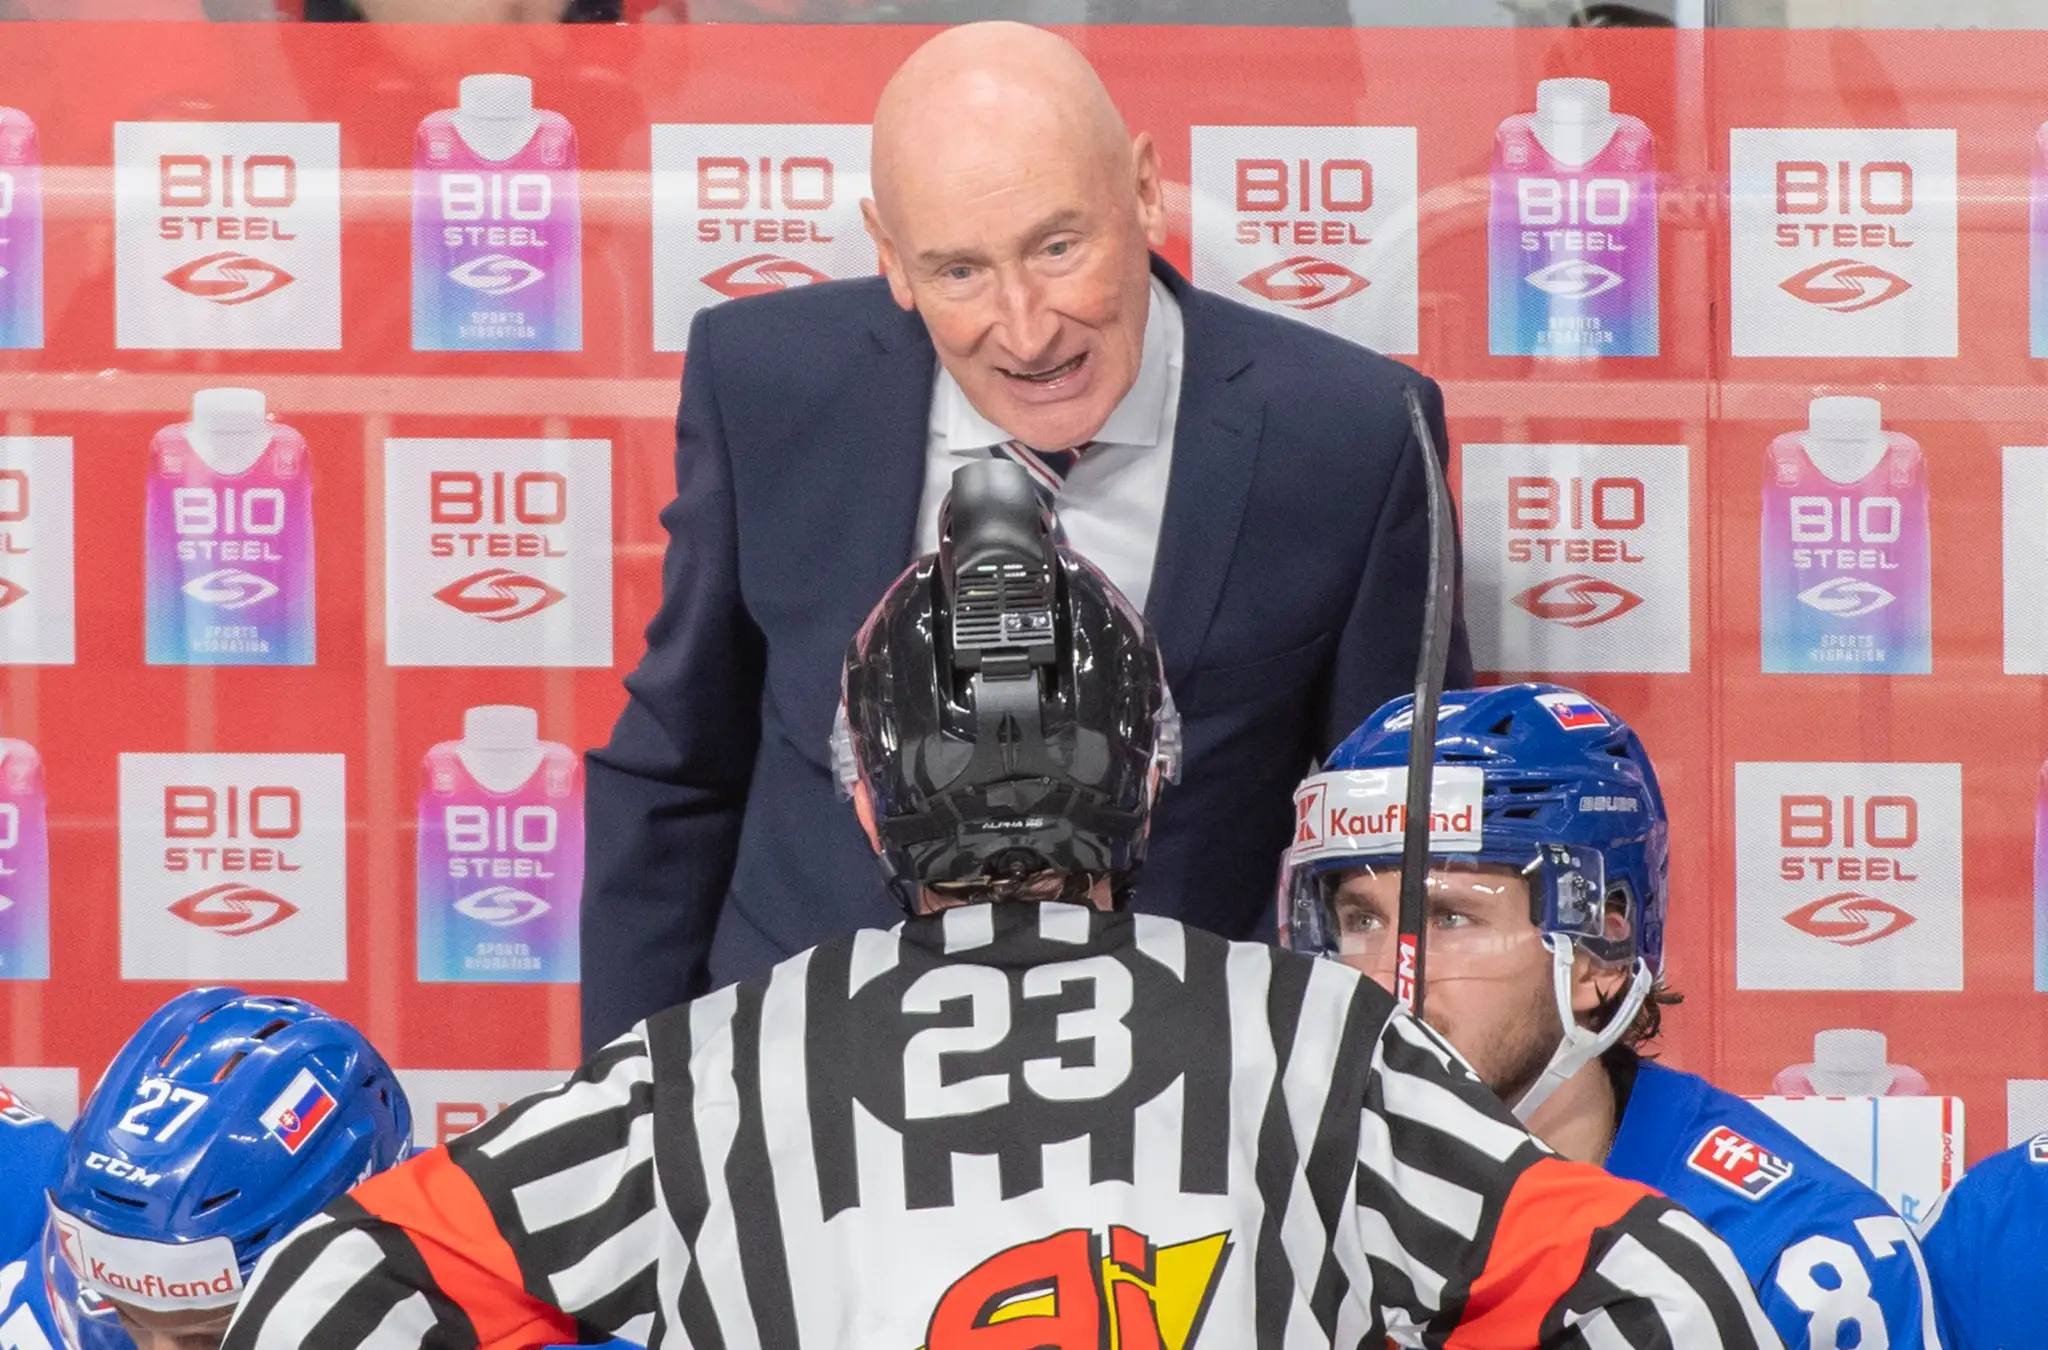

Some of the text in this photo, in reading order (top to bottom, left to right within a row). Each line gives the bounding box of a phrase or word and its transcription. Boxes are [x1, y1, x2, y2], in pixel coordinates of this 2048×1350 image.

[160, 155, 296, 207] BIO
[440, 174, 551, 220] BIO
[697, 157, 833, 209] BIO
[1236, 159, 1373, 212] BIO
[1518, 178, 1629, 224] BIO
[1775, 161, 1913, 214] BIO
[160, 217, 296, 240] STEEL
[443, 227, 548, 246] STEEL
[697, 219, 833, 243] STEEL
[1236, 222, 1372, 245] STEEL
[1521, 230, 1627, 251] STEEL
[1775, 224, 1913, 248] STEEL
[173, 488, 285, 534] BIO
[430, 471, 566, 524] BIO
[1508, 477, 1645, 530] BIO
[1790, 496, 1901, 543] BIO
[177, 540, 282, 560] STEEL
[430, 534, 567, 557] STEEL
[1508, 540, 1645, 563] STEEL
[1793, 549, 1899, 569] STEEL
[164, 787, 301, 839] BIO
[445, 806, 557, 852] BIO
[1331, 804, 1472, 837] Kauflnd
[1780, 795, 1917, 848] BIO
[164, 848, 301, 872] STEEL
[449, 858, 554, 878] STEEL
[1780, 858, 1917, 882] STEEL
[1398, 942, 1416, 1016] CM
[902, 955, 1133, 1121] 23
[118, 1076, 208, 1143] 27
[86, 1152, 161, 1187] CCM
[91, 1257, 233, 1298] Kaufland
